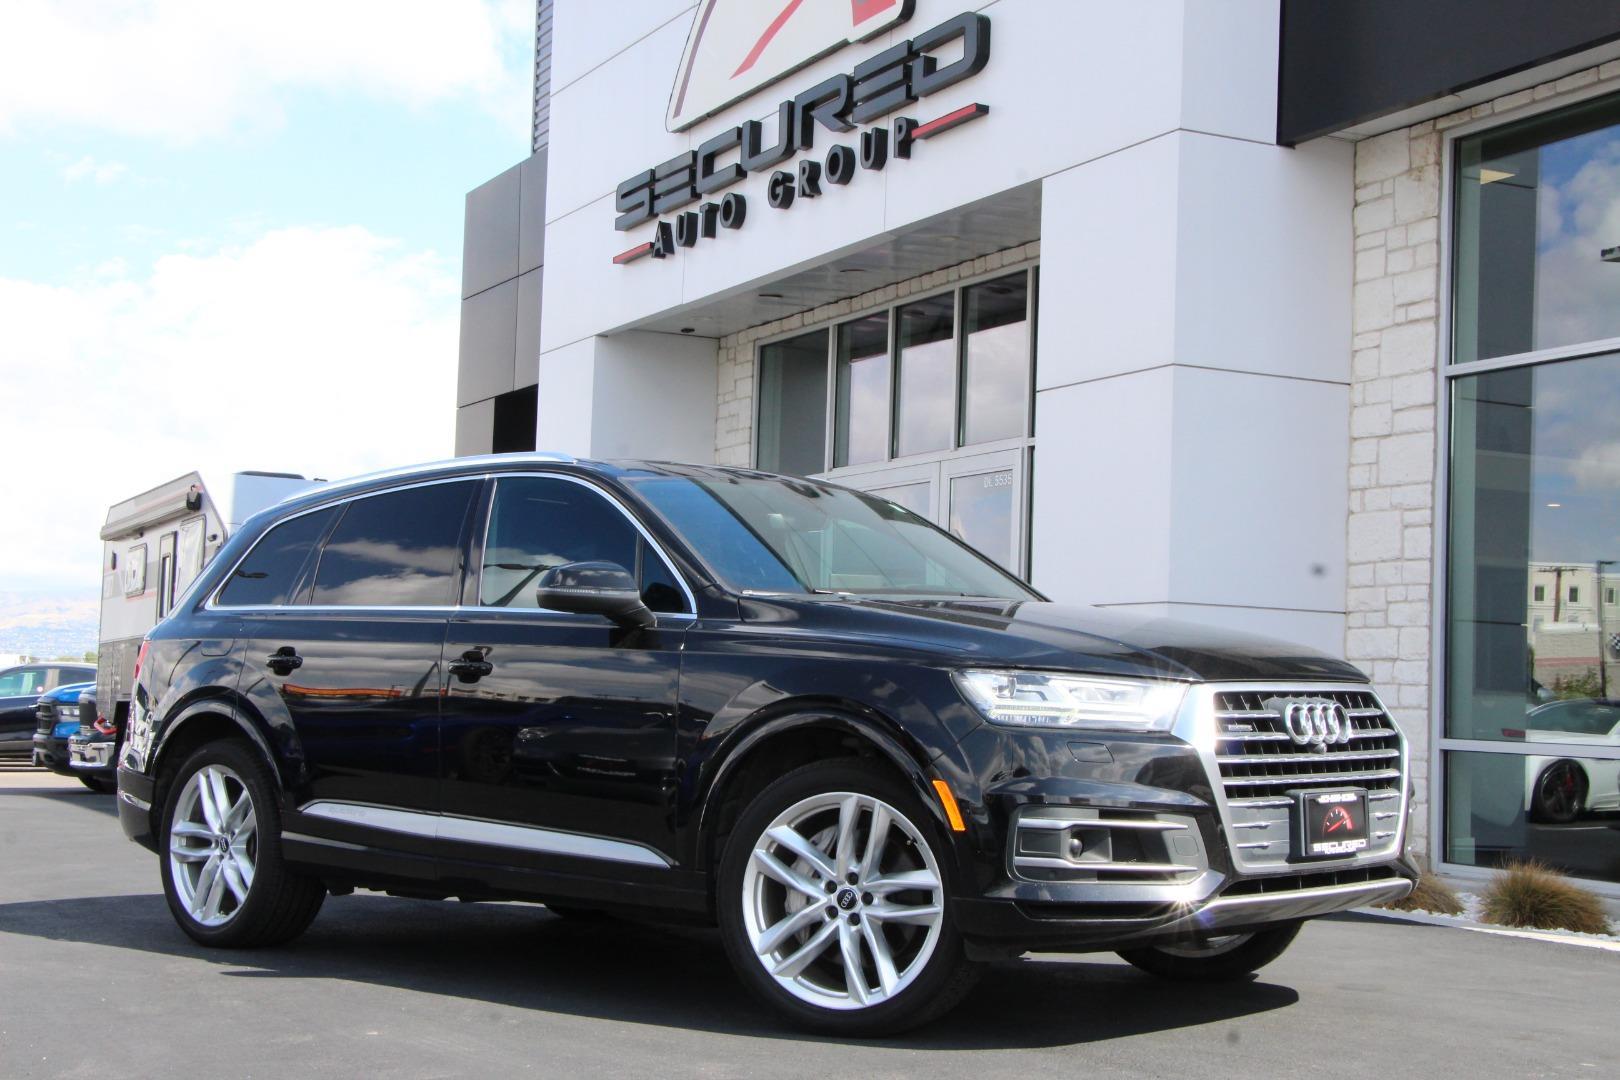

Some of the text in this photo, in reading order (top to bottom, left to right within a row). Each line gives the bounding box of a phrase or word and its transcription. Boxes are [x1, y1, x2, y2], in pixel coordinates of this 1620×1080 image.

[615, 11, 992, 232] SECURED
[651, 116, 919, 259] AUTO GROUP
